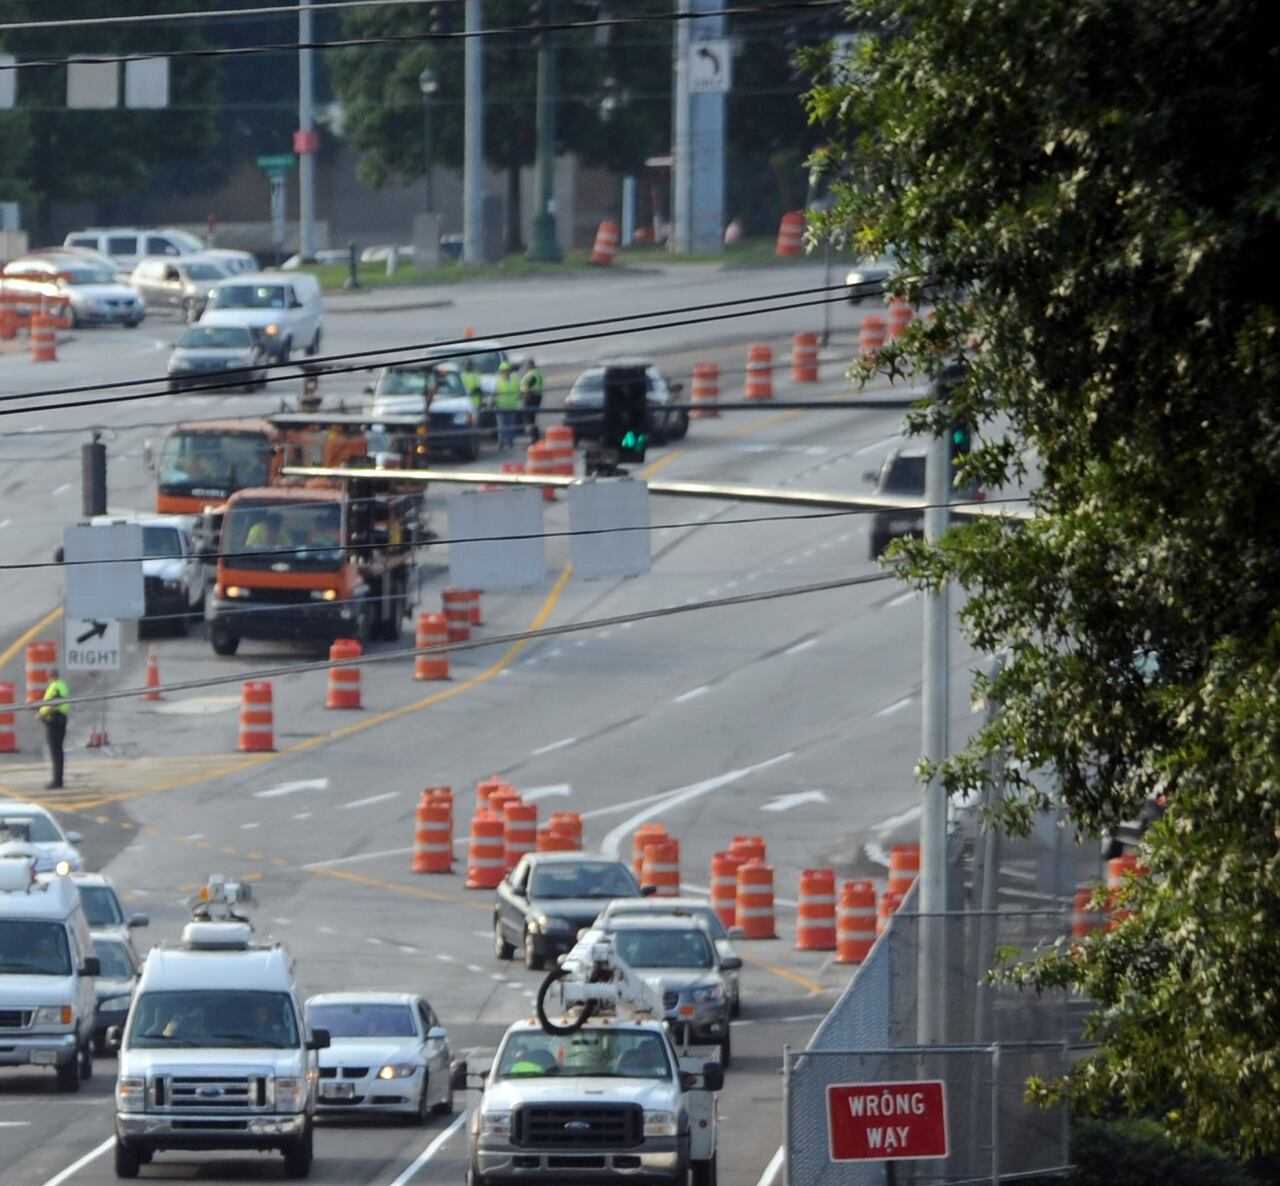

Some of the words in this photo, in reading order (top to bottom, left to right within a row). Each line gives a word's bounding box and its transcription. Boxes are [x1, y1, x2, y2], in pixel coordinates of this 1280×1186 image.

[68, 650, 118, 665] RIGHT
[848, 1092, 925, 1117] WRONG
[866, 1126, 910, 1149] WAY
